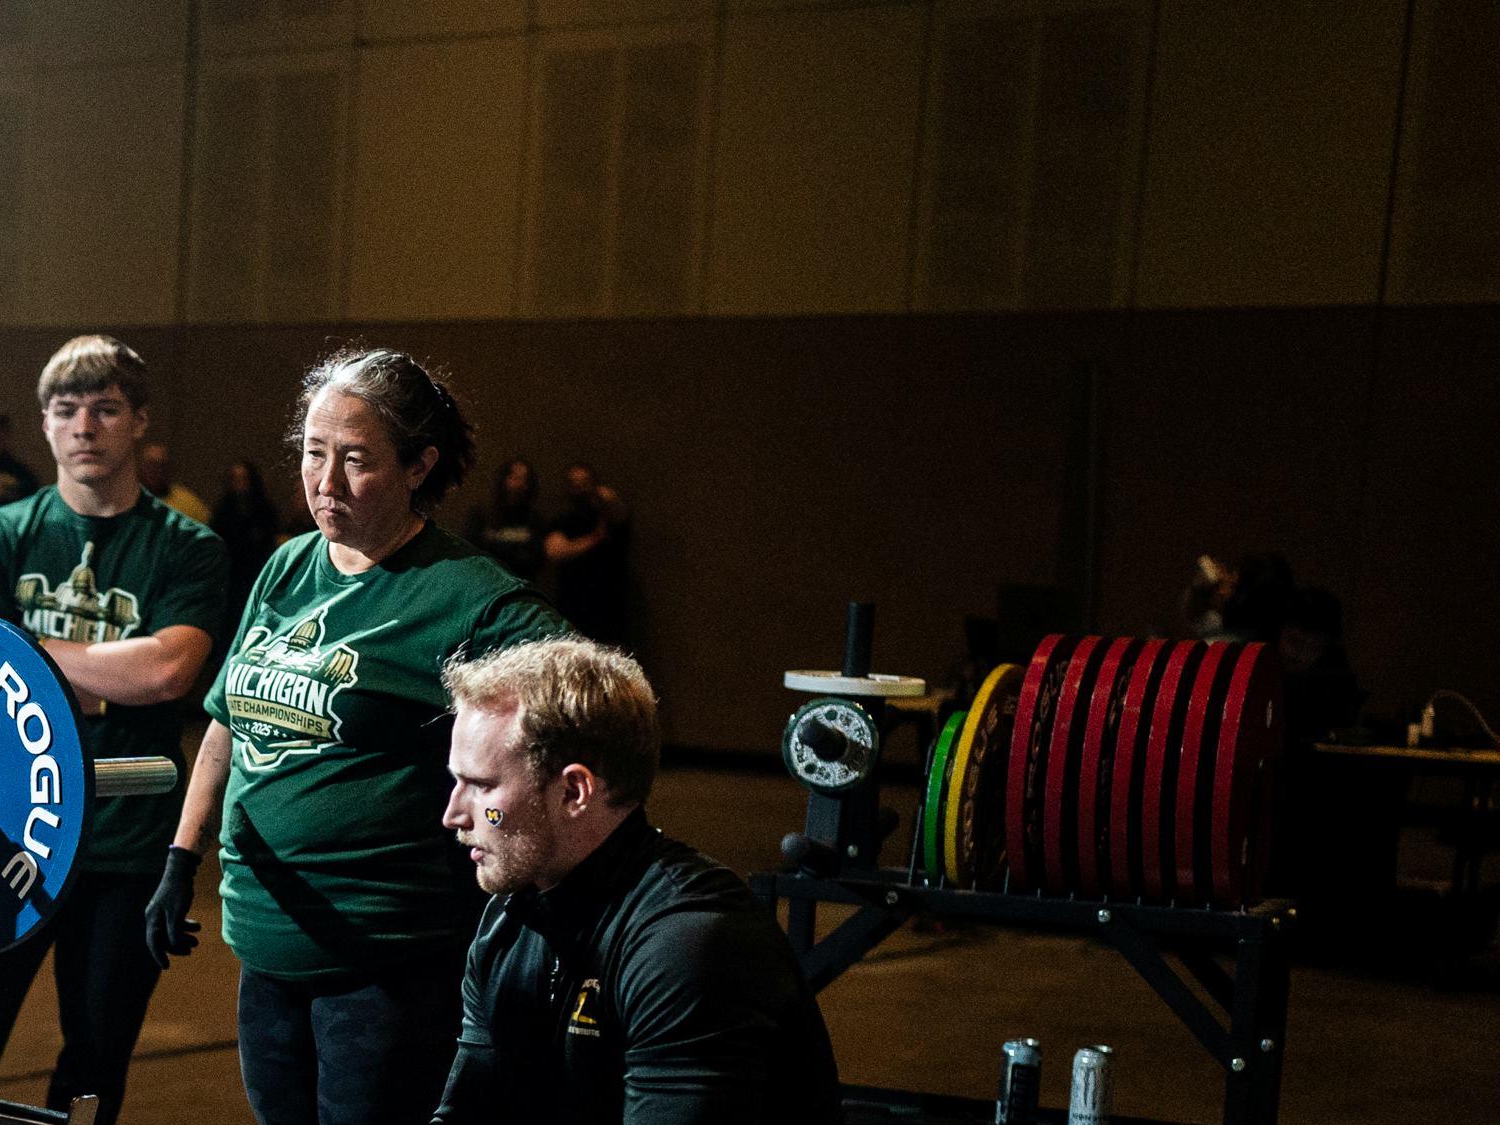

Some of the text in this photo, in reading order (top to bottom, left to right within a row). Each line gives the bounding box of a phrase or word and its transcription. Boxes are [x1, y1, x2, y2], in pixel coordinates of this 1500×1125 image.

[226, 663, 329, 717] MICHIGAN
[244, 701, 323, 732] CHAMPIONSHIPS
[251, 721, 272, 736] 2025
